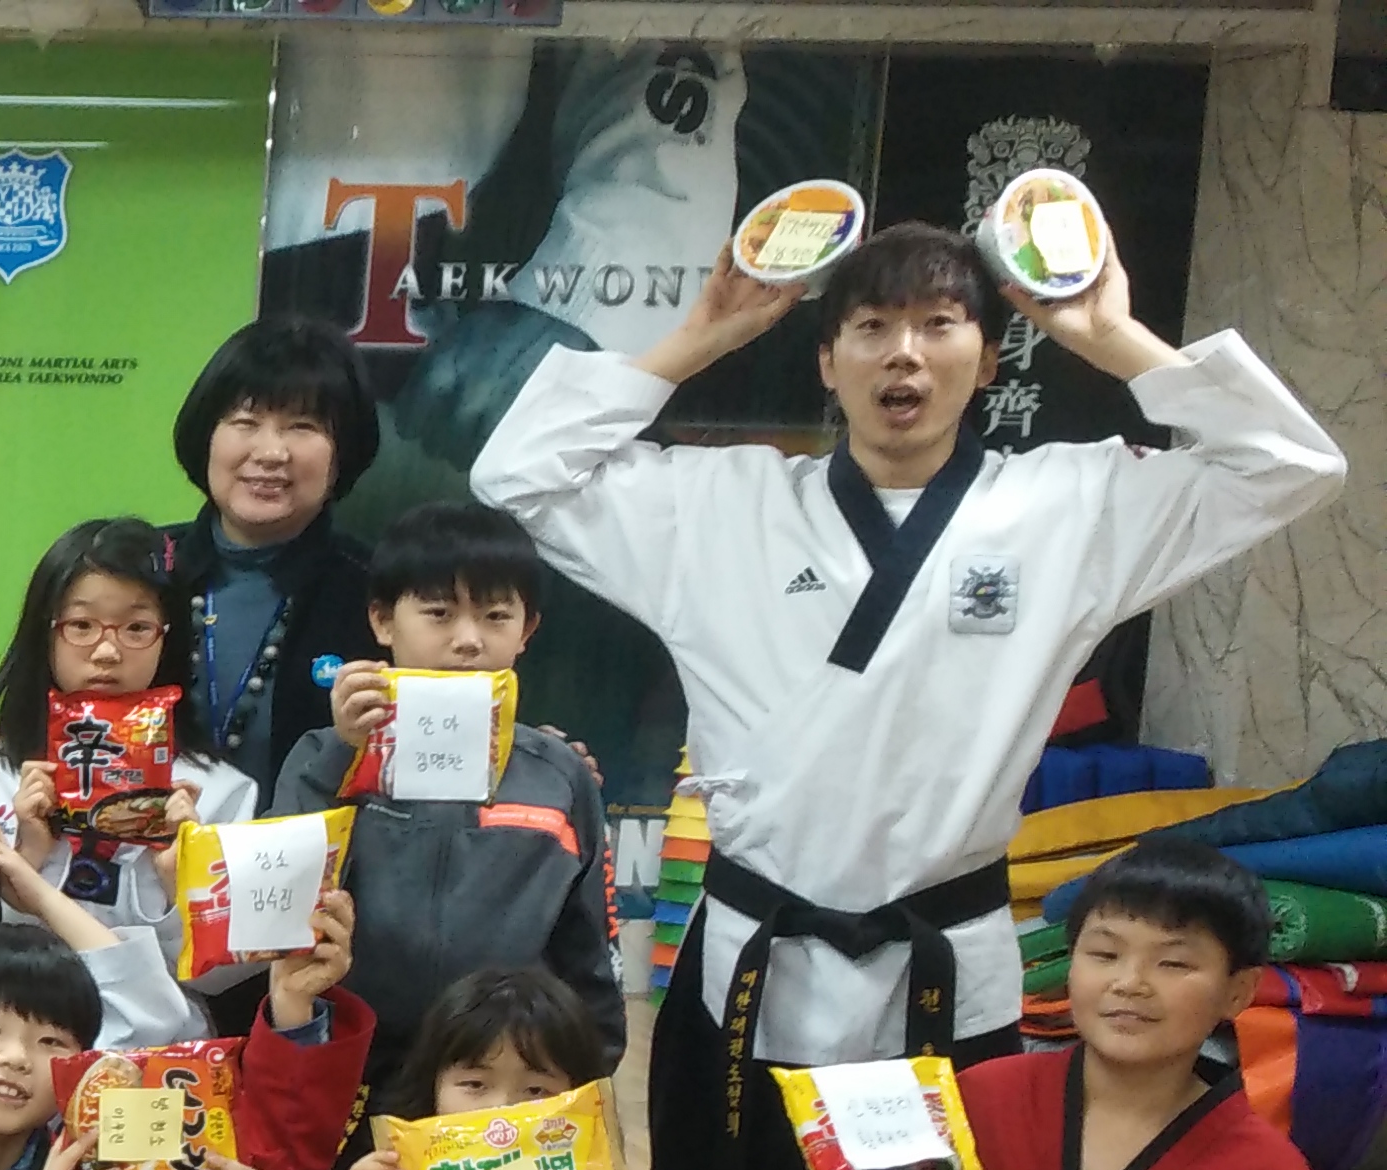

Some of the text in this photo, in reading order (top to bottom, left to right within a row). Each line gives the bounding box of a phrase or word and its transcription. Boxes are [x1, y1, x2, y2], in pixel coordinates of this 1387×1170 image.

[324, 178, 719, 347] TAEKWON
[28, 356, 95, 369] MARTIAL
[99, 357, 138, 369] ARTS
[27, 373, 123, 384] TAEKWONDO
